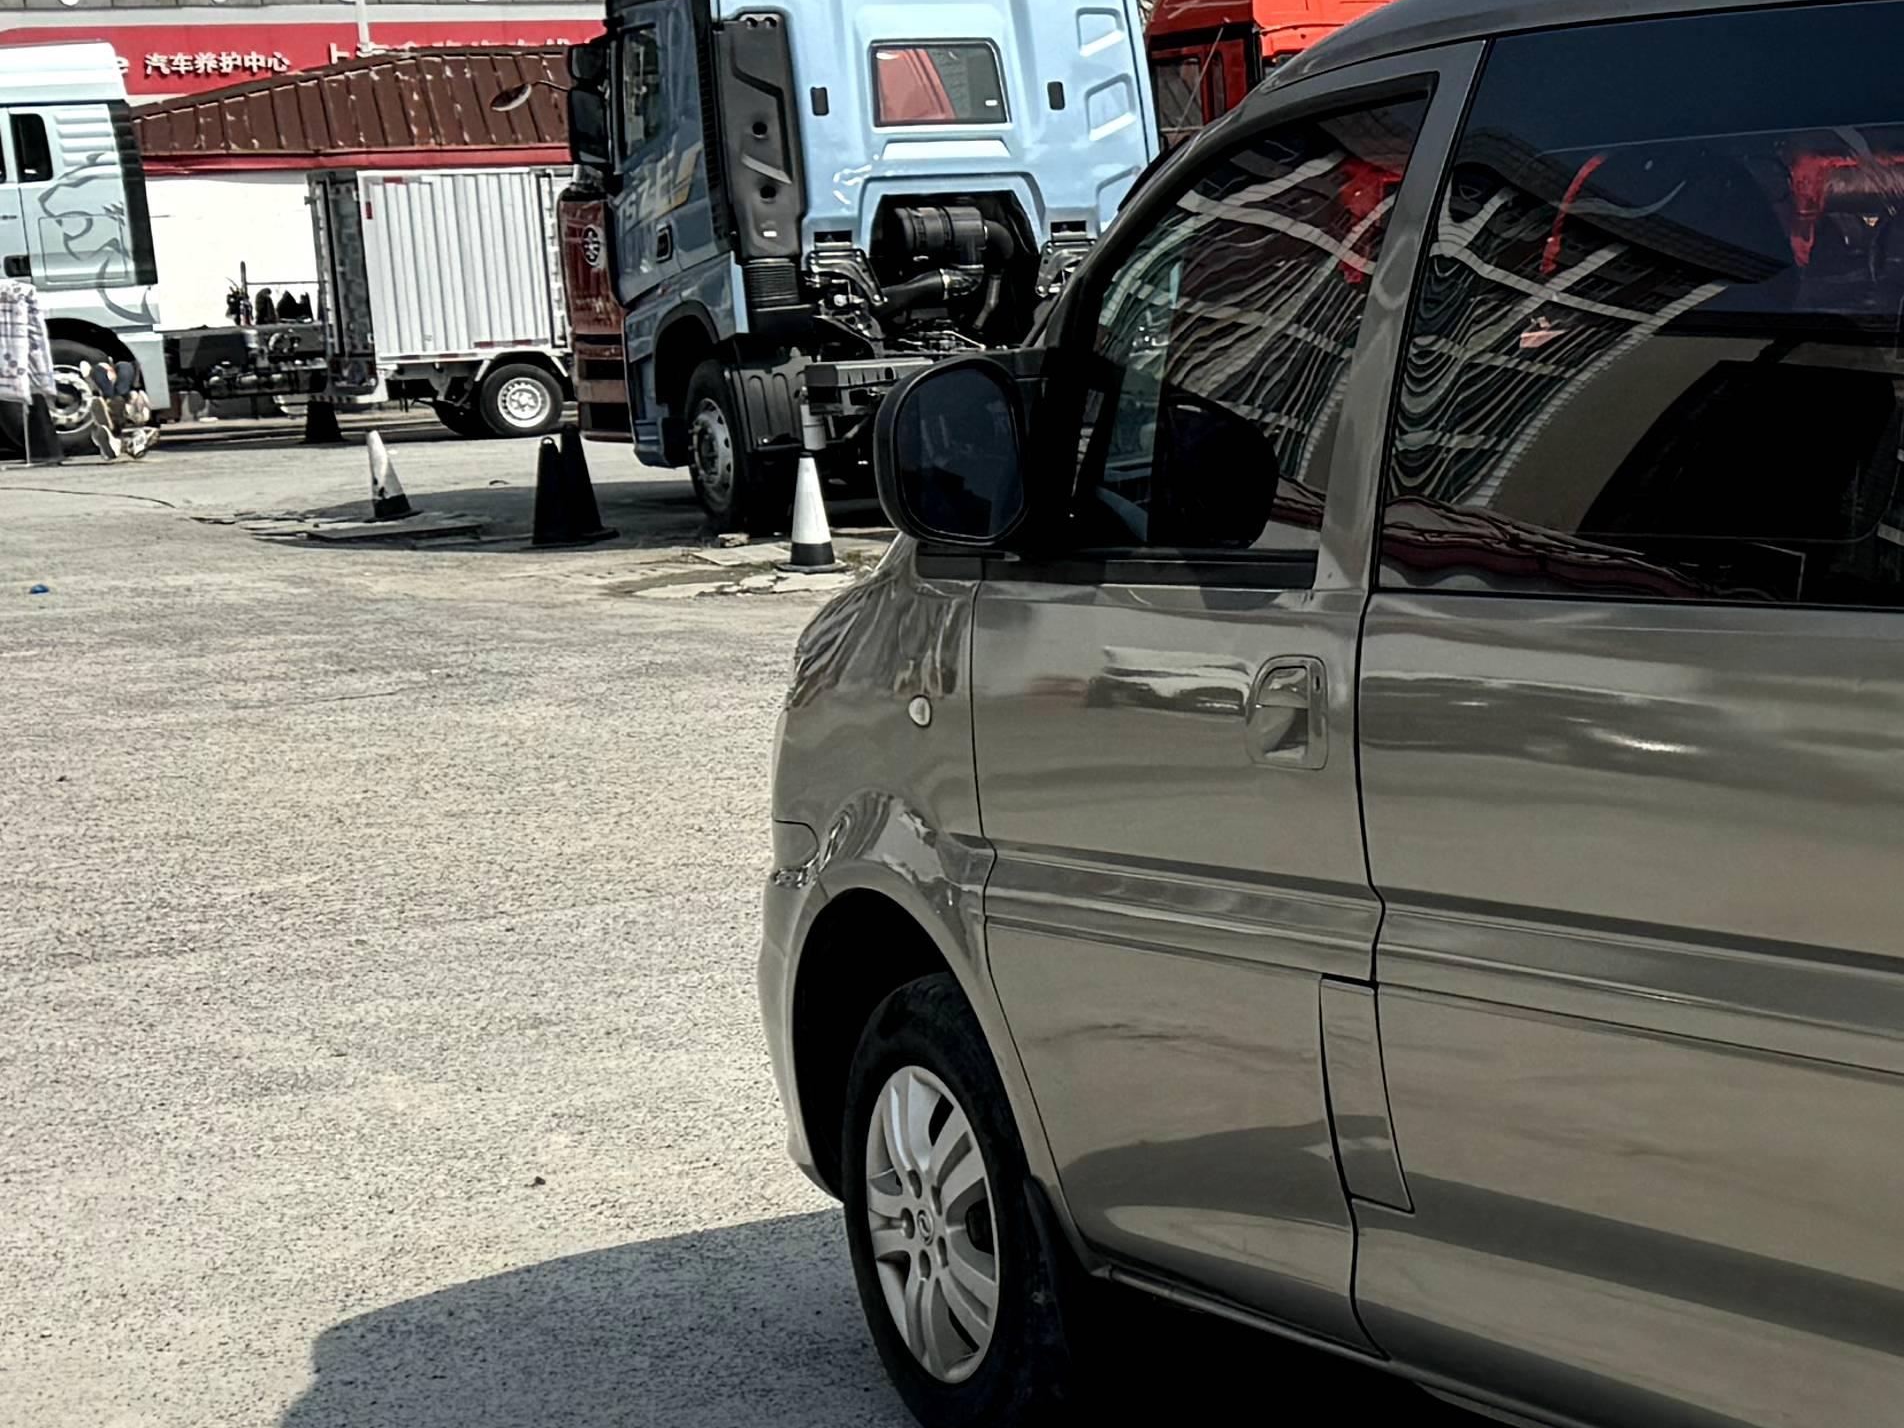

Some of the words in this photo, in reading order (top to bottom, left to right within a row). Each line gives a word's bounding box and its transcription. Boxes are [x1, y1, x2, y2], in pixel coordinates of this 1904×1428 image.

[144, 51, 291, 75] 汽车养护中心
